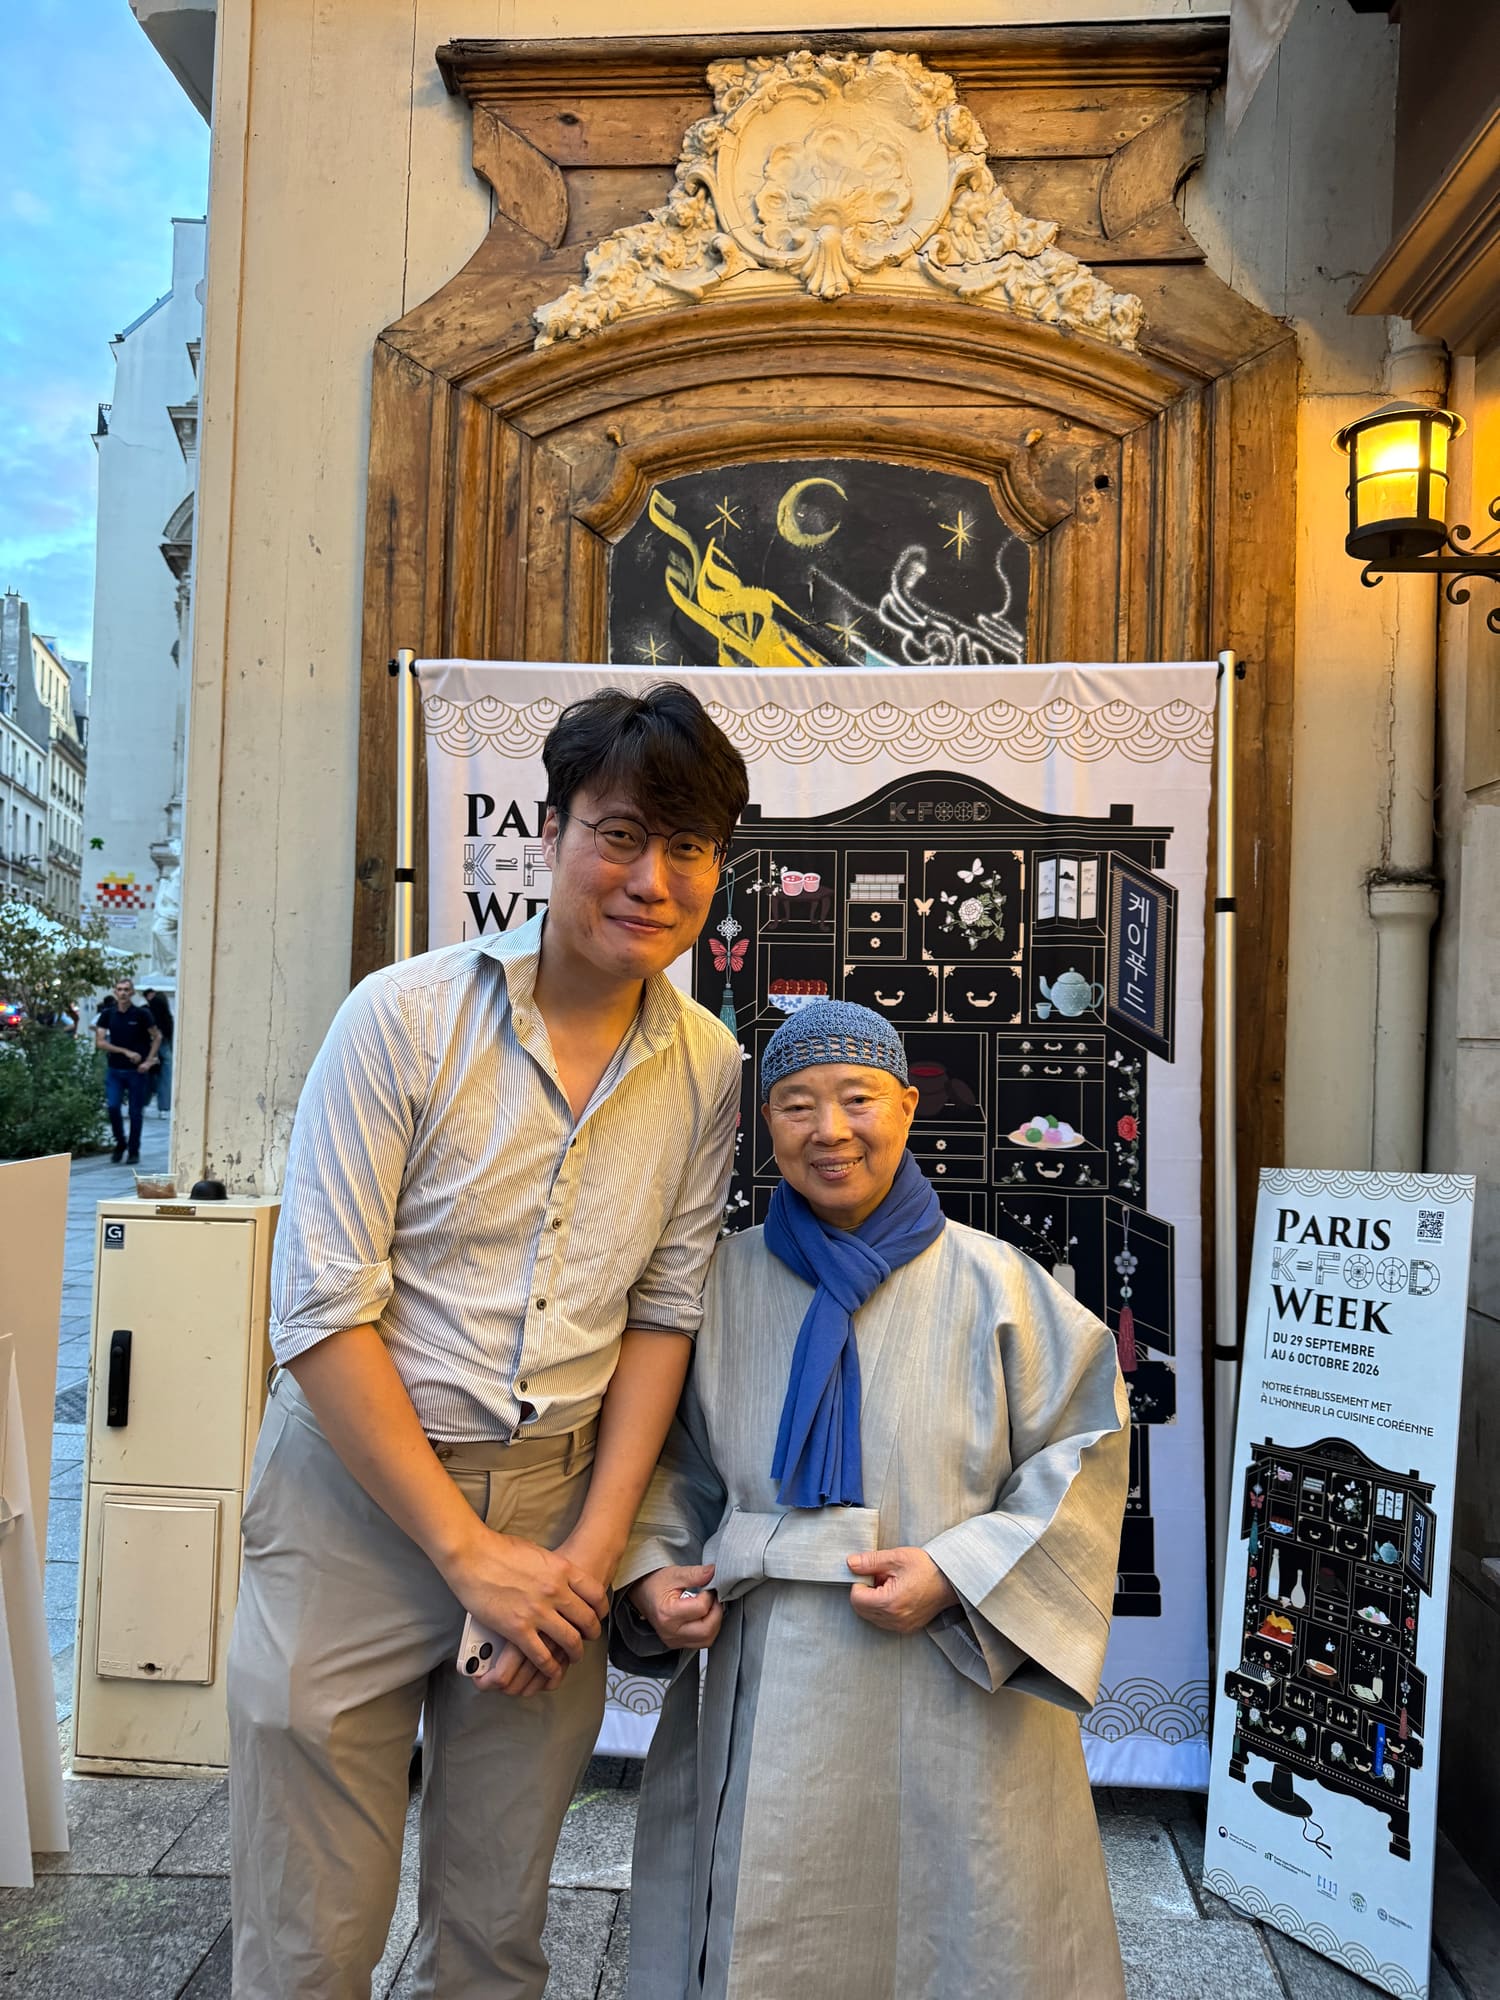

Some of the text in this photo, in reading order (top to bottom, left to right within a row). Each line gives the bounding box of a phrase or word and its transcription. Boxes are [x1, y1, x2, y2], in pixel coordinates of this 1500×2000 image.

[889, 801, 991, 822] K-FOOD
[1123, 892, 1150, 1014] 케이푸드
[108, 1226, 122, 1239] G
[1274, 1208, 1391, 1251] PARIS
[1271, 1247, 1440, 1297] K-FOOD
[1270, 1284, 1393, 1335] WEEK
[1271, 1349, 1379, 1376] AU 6 OCTOBRE 2026
[1273, 1332, 1375, 1357] DU 29 SEPTEMBRE
[1261, 1392, 1434, 1437] À L'HONNEUR LA CUISINE CORÉENNE
[1262, 1380, 1392, 1412] NOTRE ÉTABLISSEMENT MET
[1411, 1511, 1425, 1571] 케이푸드
